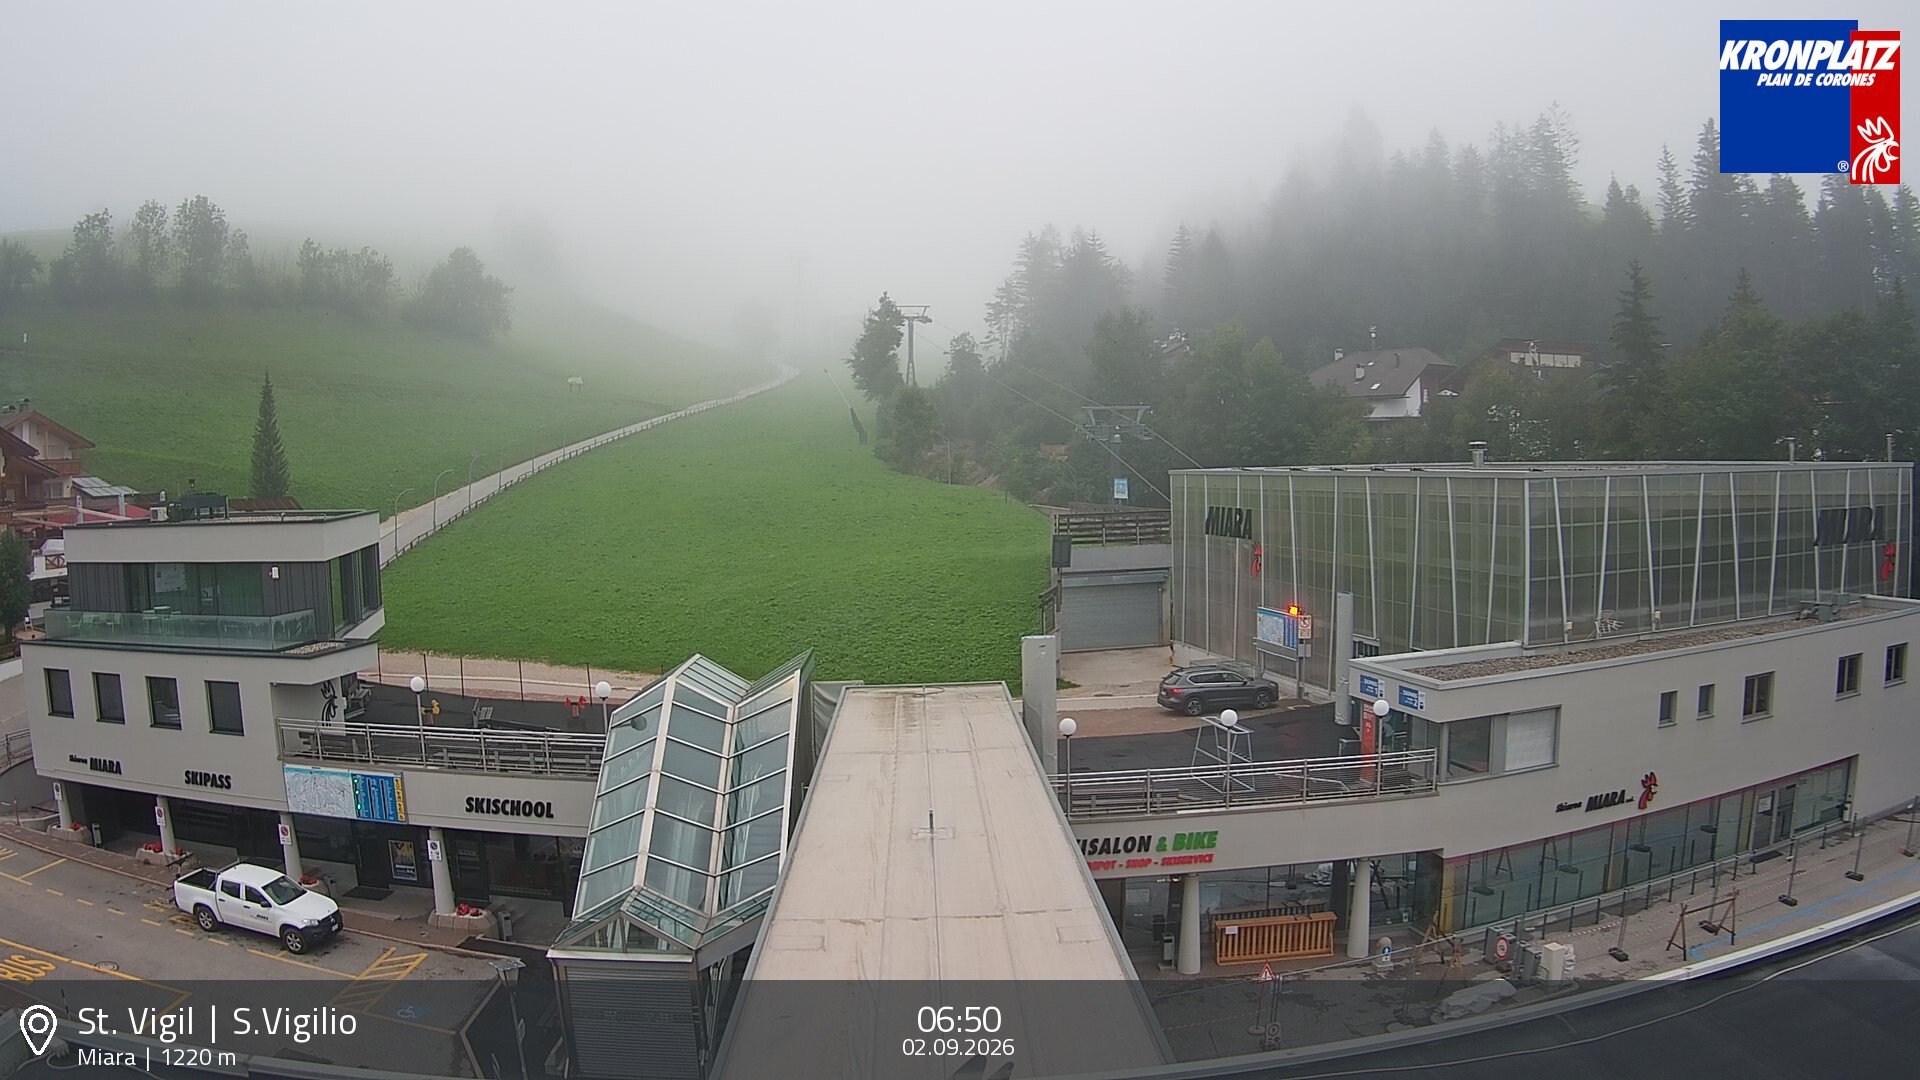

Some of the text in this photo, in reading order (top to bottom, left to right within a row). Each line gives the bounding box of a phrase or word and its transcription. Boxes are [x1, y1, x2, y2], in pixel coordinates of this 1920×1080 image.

[1205, 506, 1252, 540] MIARA
[90, 757, 122, 775] MIARA
[184, 769, 232, 790] SKIPASS
[465, 796, 554, 819] SKISCHOOL
[1585, 789, 1626, 812] MIARA
[1155, 836, 1168, 853] &
[1172, 830, 1219, 851] BIKE
[1125, 858, 1153, 869] SHOP
